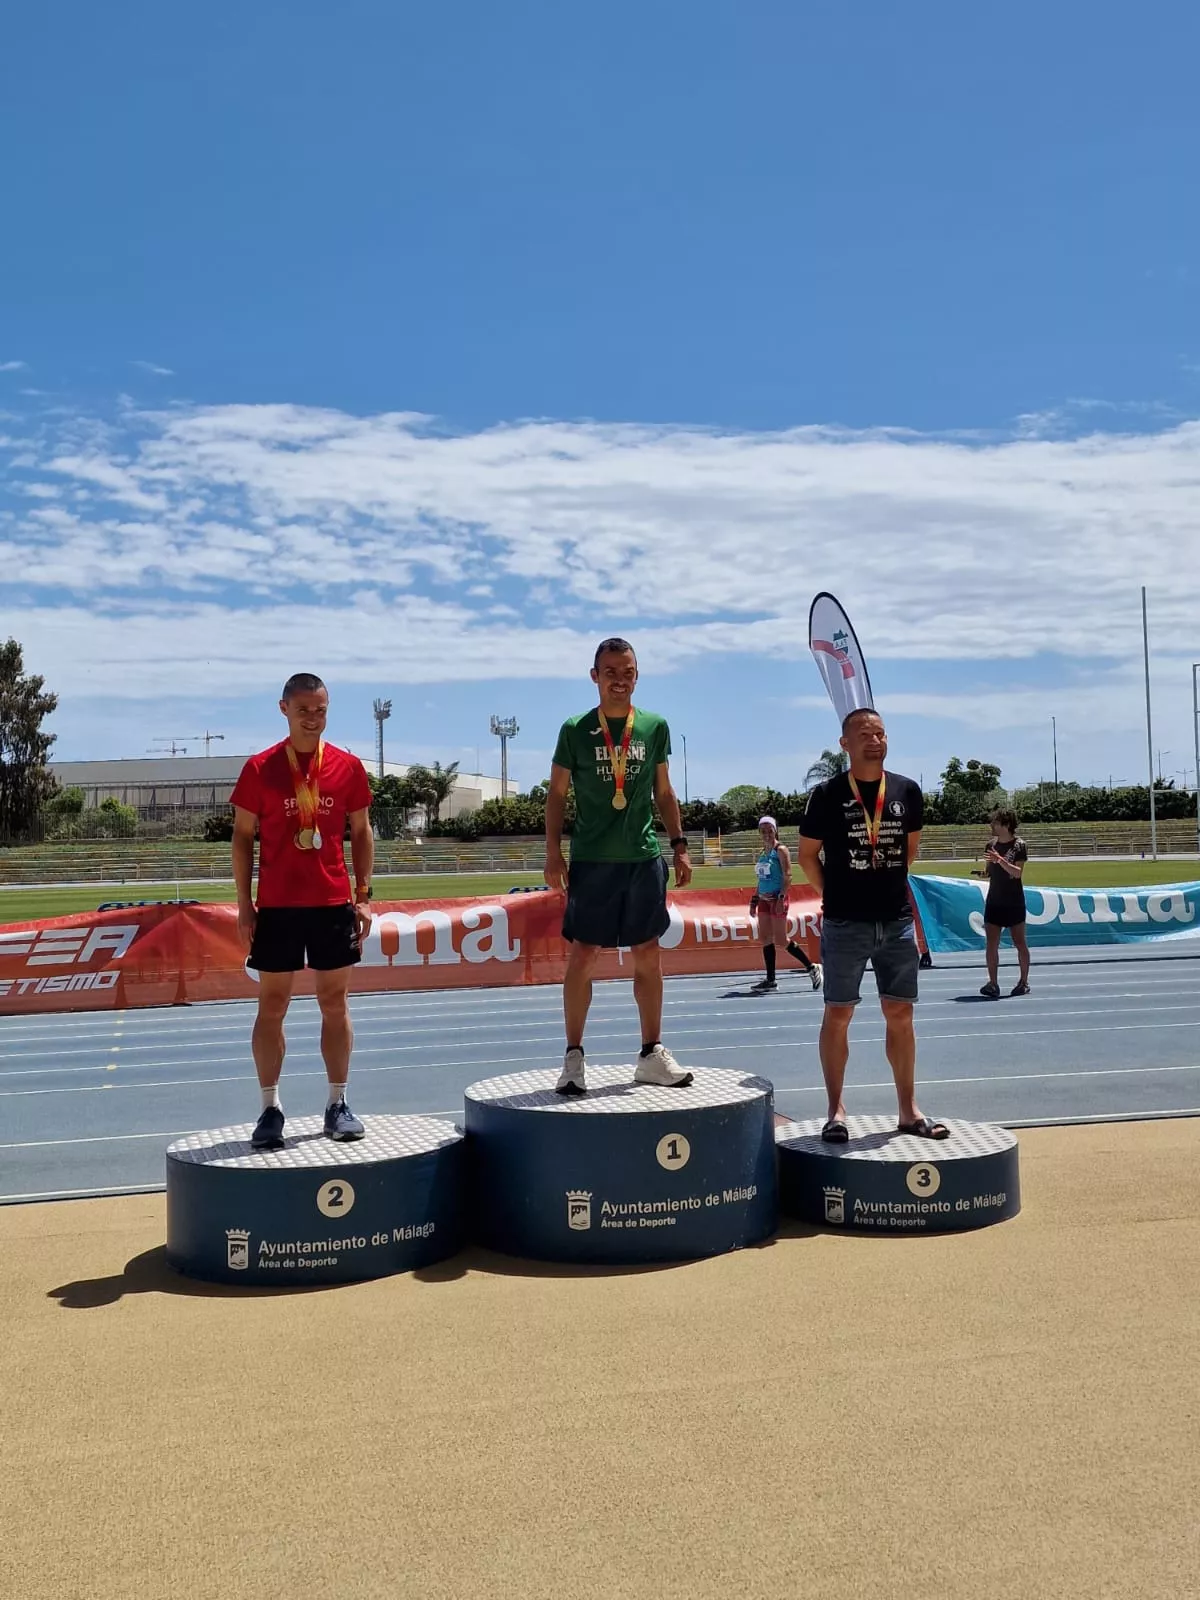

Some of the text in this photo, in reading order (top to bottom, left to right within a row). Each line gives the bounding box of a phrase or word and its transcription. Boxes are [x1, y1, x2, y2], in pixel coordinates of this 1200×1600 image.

[667, 1139, 681, 1160] 1
[916, 1168, 931, 1187] 3
[327, 1186, 344, 1207] 2
[601, 1184, 758, 1217] Ayuntamiento de Málaga
[853, 1192, 1007, 1217] Ayuntamiento de Málaga
[601, 1216, 676, 1229] Área de Deporte
[853, 1215, 926, 1227] Área de Deporte
[258, 1221, 436, 1257] Ayuntamiento de Málaga
[258, 1256, 338, 1269] Área de Deporte
